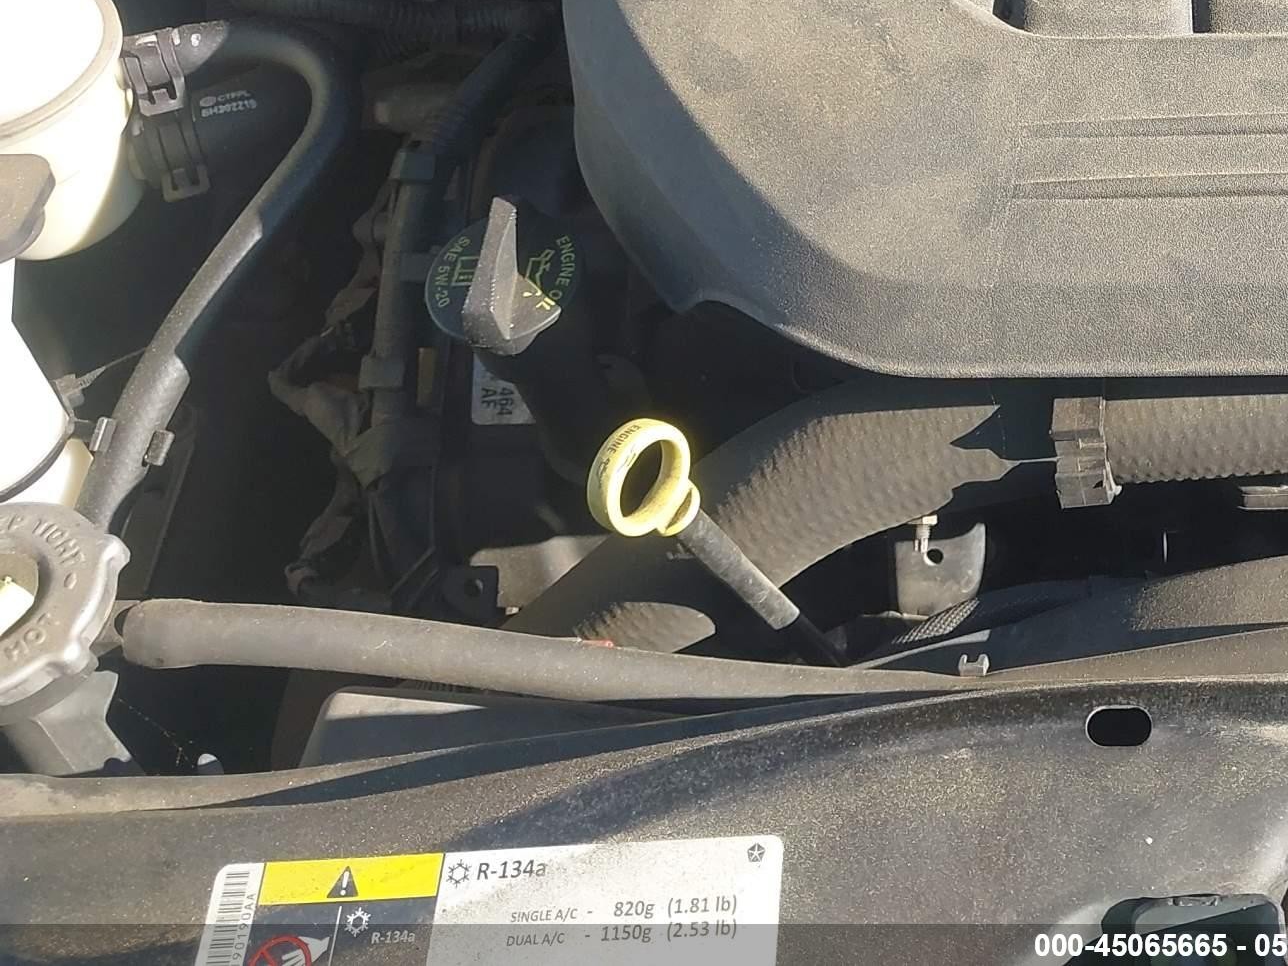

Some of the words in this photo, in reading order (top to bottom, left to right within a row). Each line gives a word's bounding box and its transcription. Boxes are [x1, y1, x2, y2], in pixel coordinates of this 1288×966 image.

[443, 236, 471, 263] SAE
[556, 236, 575, 287] ENGINE
[434, 265, 450, 308] 5W-20
[607, 424, 640, 455] ENGINE
[476, 859, 548, 880] R-134a
[511, 909, 552, 923] SINGLE
[554, 907, 578, 922] A/C
[613, 901, 655, 919] 820g
[667, 897, 710, 919] (1.81
[715, 895, 738, 915] lb)
[371, 930, 416, 945] R-134a
[506, 933, 540, 947] DUAL
[542, 932, 565, 947] A/C
[601, 924, 652, 944] 1150g
[666, 921, 710, 943] (2.53
[715, 918, 737, 940] lb)
